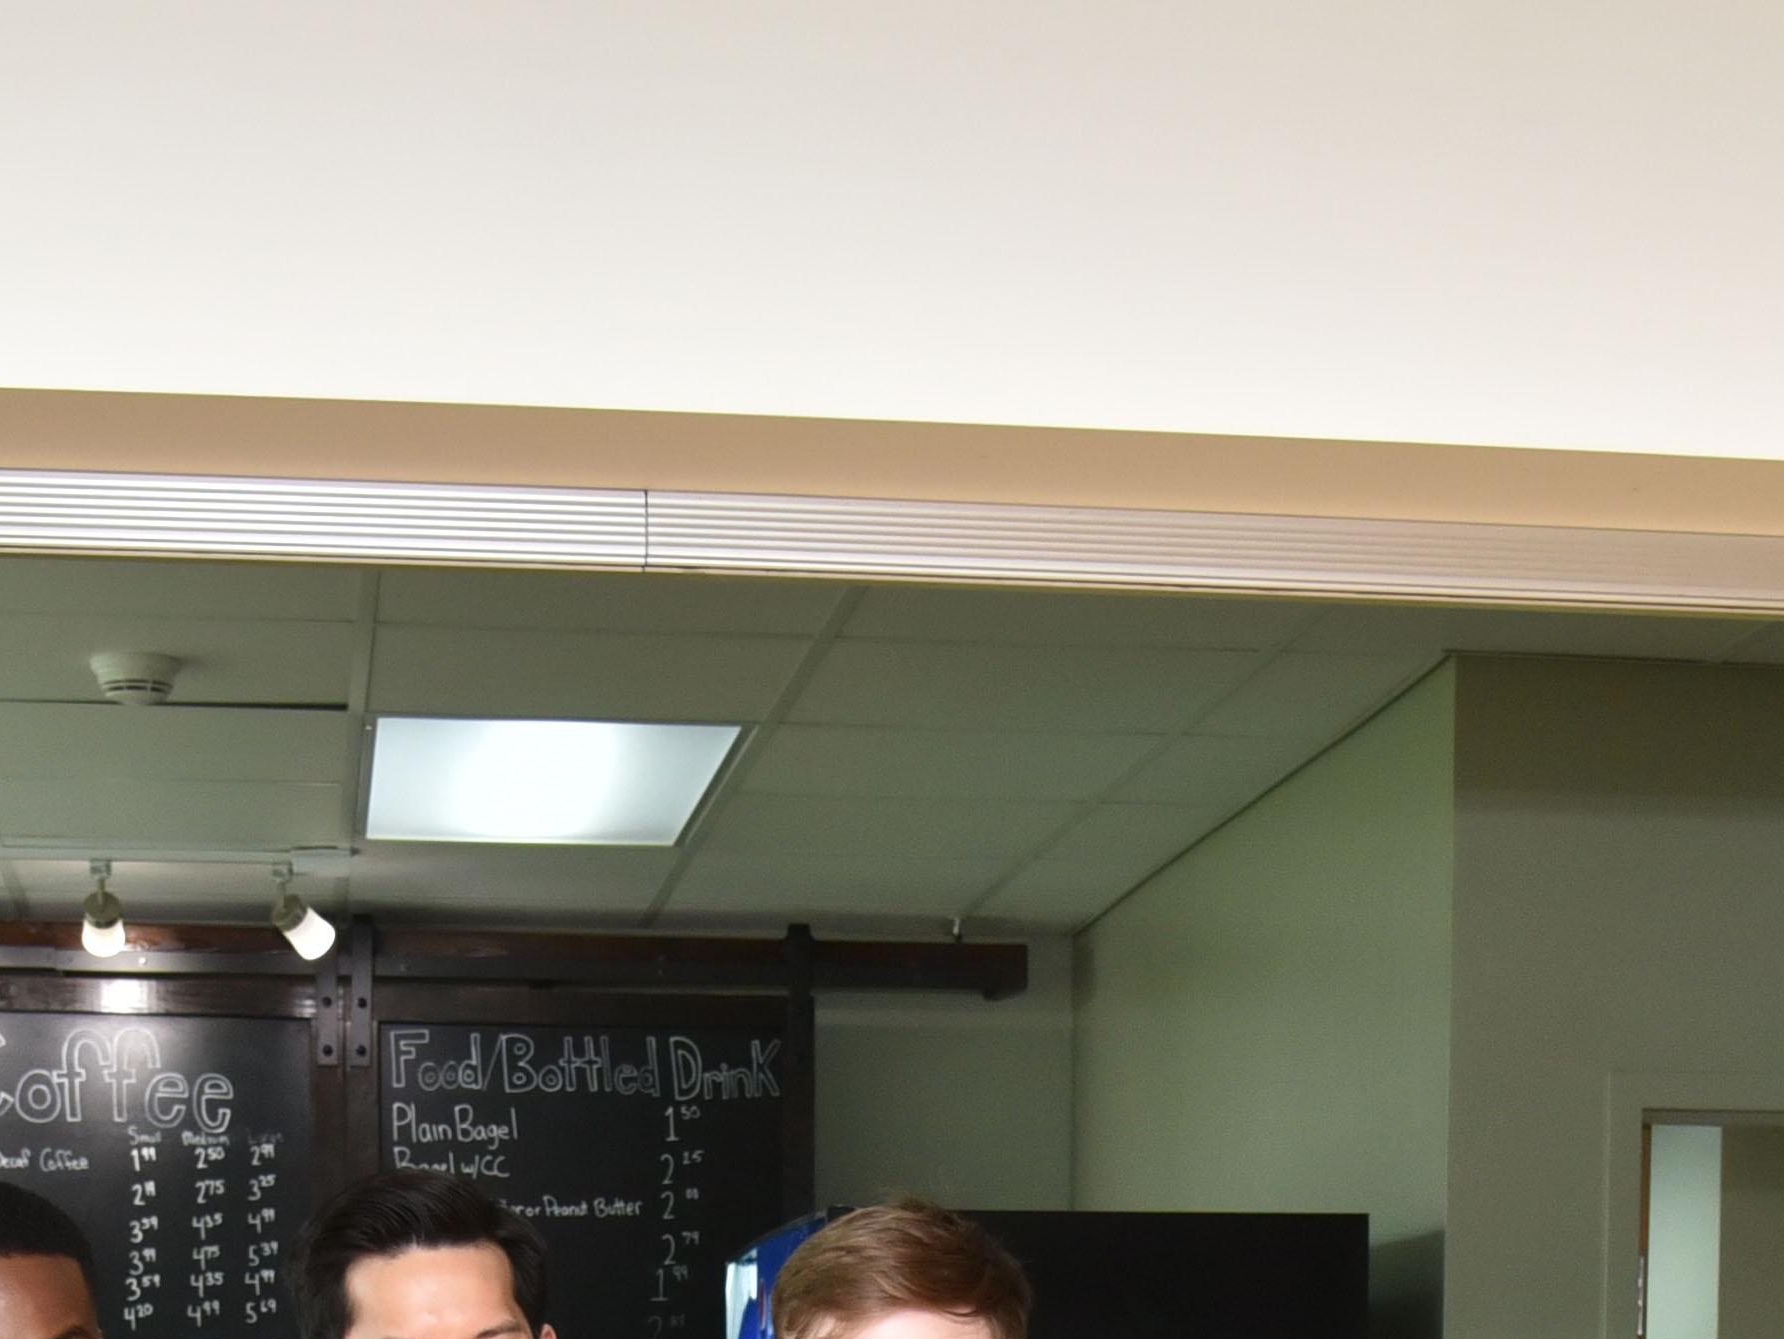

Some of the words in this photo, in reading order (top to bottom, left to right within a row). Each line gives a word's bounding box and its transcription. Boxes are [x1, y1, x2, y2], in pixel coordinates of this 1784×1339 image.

[392, 1102, 453, 1143] Plain
[454, 1104, 517, 1149] Bagel
[593, 1197, 644, 1218] Butter
